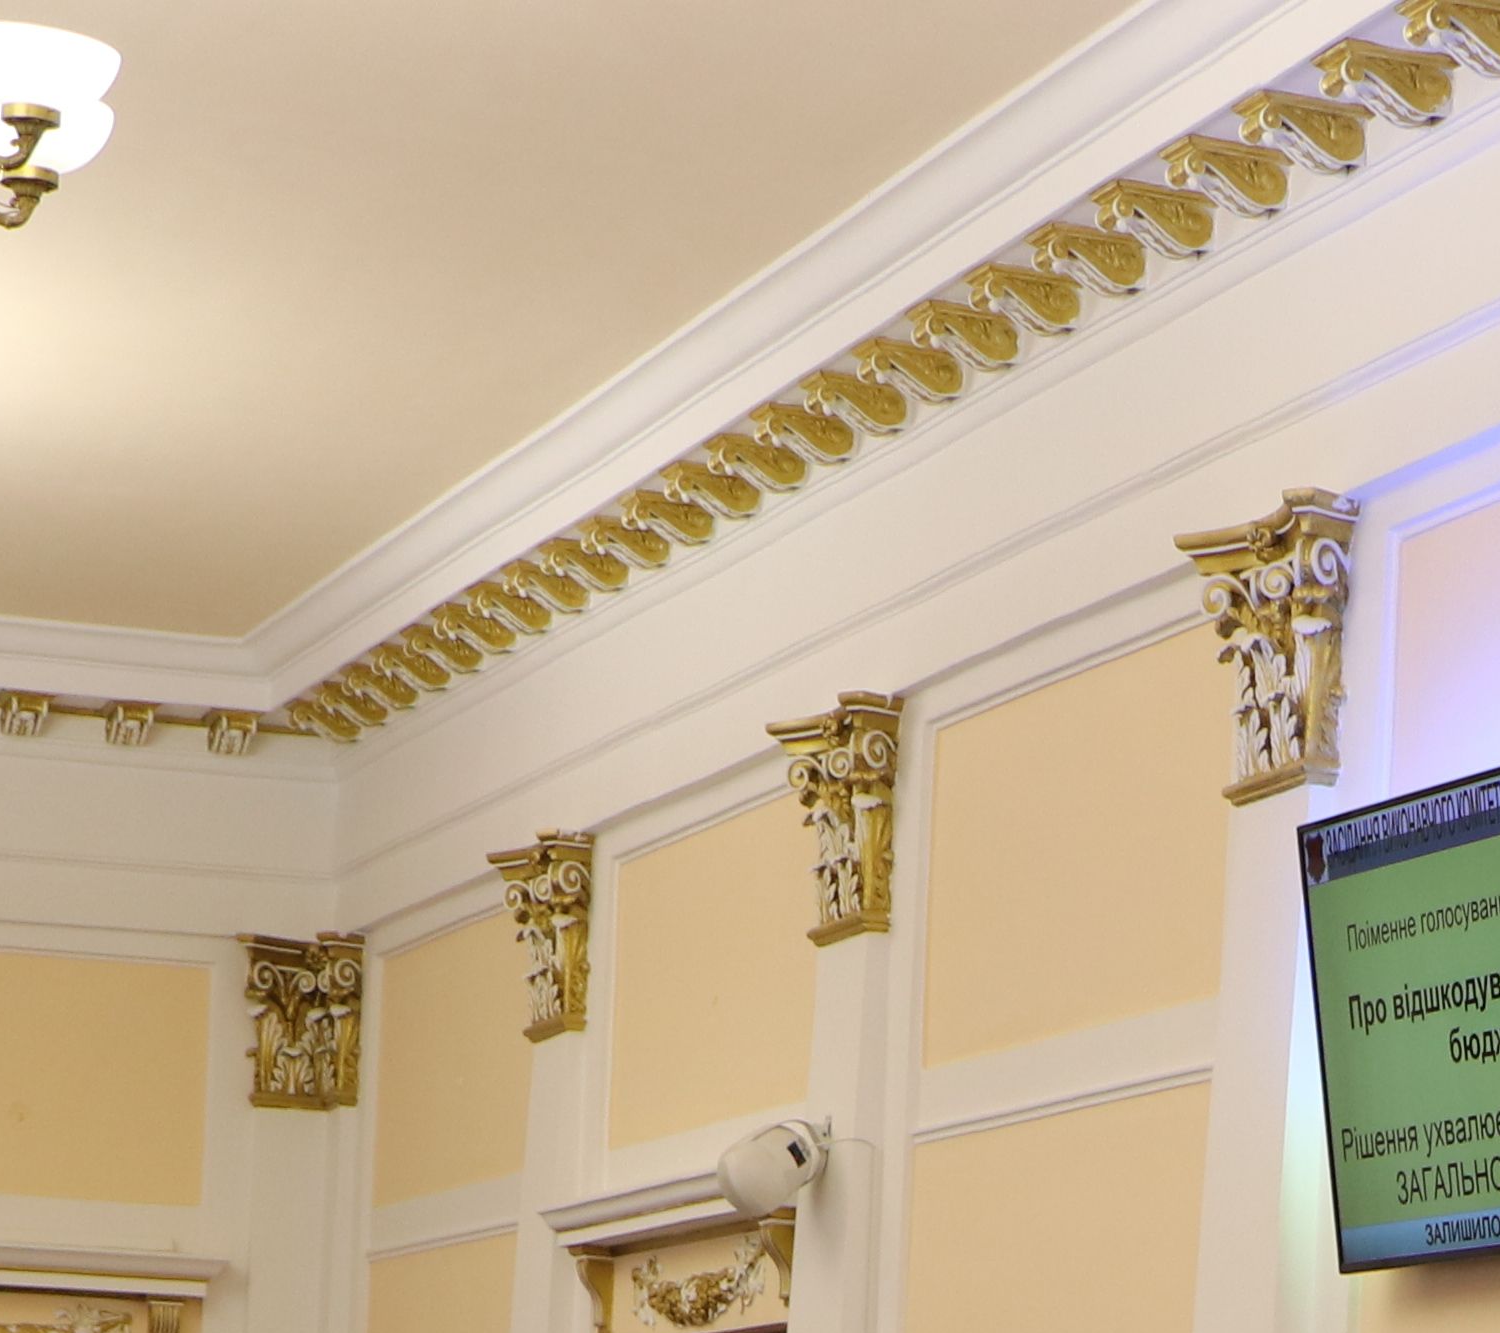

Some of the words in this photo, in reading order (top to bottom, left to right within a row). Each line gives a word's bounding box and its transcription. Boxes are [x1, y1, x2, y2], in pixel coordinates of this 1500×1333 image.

[1347, 914, 1417, 952] Поіменне
[1349, 993, 1387, 1035] Про
[1342, 1124, 1418, 1162] Рішення
